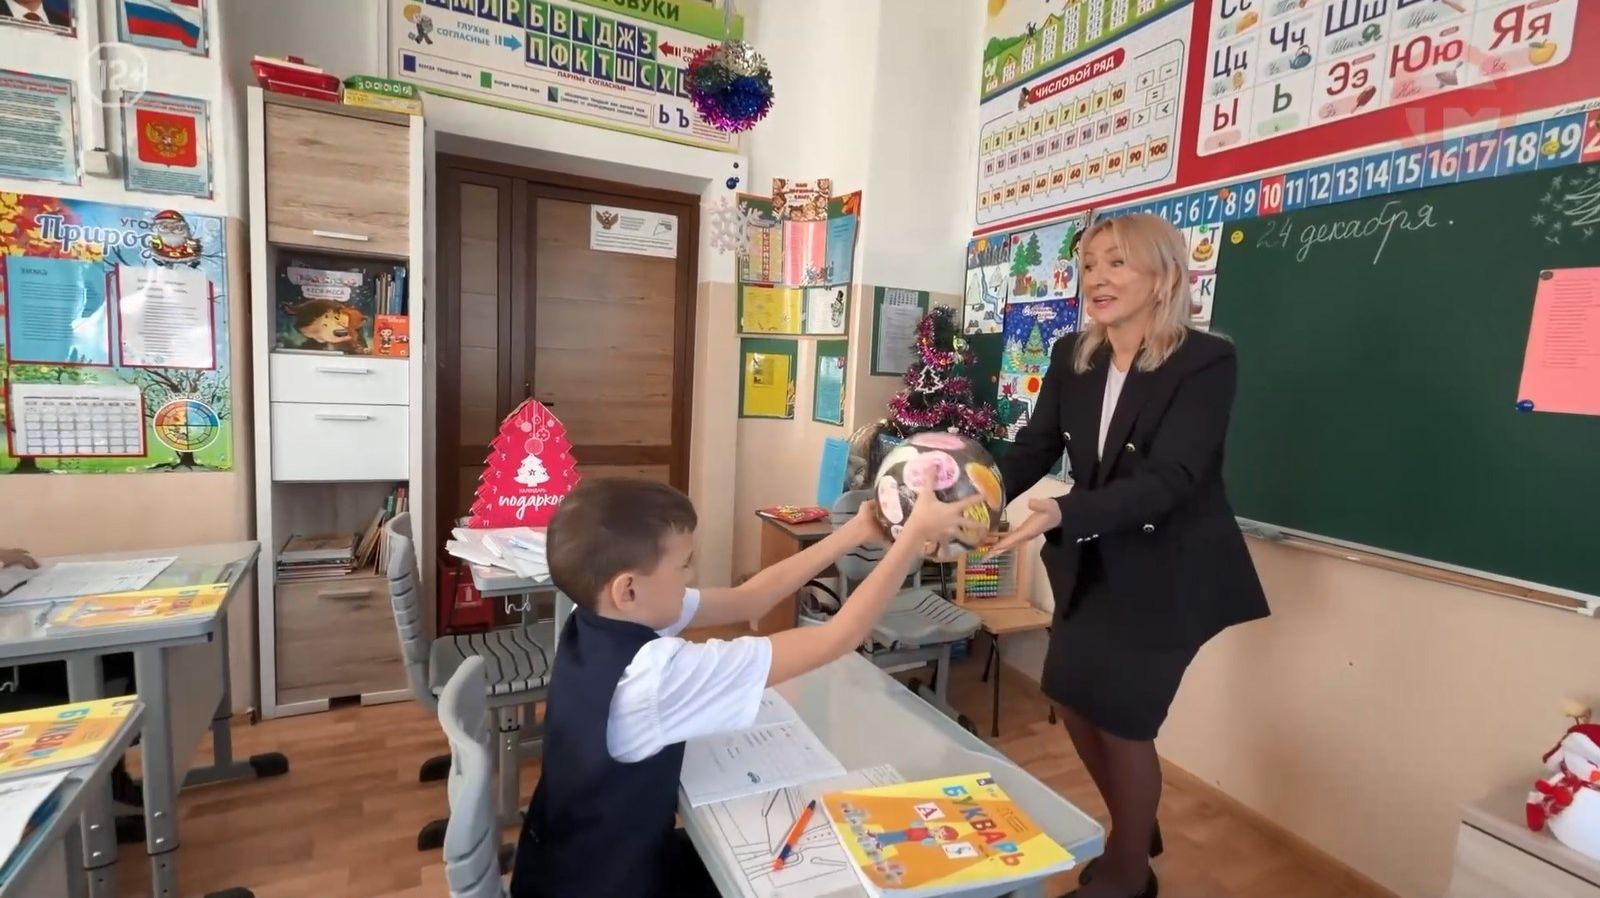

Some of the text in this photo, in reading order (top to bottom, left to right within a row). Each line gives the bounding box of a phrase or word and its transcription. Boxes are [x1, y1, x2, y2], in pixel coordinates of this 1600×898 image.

[456, 21, 490, 36] ГЛУХИЕ
[507, 0, 520, 21] Р
[530, 3, 544, 28] Б
[554, 9, 567, 33] В
[577, 16, 589, 39] Г
[597, 22, 613, 48] Д
[617, 26, 635, 52] Ж
[641, 33, 652, 54] З
[1325, 0, 1387, 37] Шш
[1488, 4, 1552, 51] Яя
[436, 27, 491, 47] СОГЛАСНЫЕ
[1270, 21, 1306, 53] Чч
[530, 37, 672, 91] П Ф К Т Ш С Х
[1213, 46, 1248, 78] Цц
[1389, 35, 1464, 78] Юю
[557, 71, 627, 91] ПАРНЫЕ СОГЛАСНЫЕ
[1035, 56, 1115, 97] ЧИСЛОВОЙ РЯД
[1326, 61, 1369, 96] Ээ
[1096, 97, 1103, 107] 9
[1112, 89, 1122, 101] 10
[1272, 83, 1292, 114] Ь
[676, 107, 690, 128] Ъ
[1116, 116, 1127, 128] 20
[1213, 97, 1239, 132] Ы
[1006, 188, 1015, 198] 20
[1069, 168, 1081, 180] 60
[1088, 162, 1100, 174] 70
[1108, 156, 1121, 169] 80
[1129, 151, 1142, 163] 90
[1149, 143, 1168, 157] 100
[1173, 202, 1183, 225] 5
[1189, 199, 1200, 222] 6
[1206, 195, 1219, 219] 7
[1225, 191, 1236, 216] 8
[1244, 188, 1256, 213] 9
[1262, 182, 1281, 209] 10
[1286, 178, 1303, 205] 11
[1310, 172, 1331, 201] 12
[1336, 166, 1360, 196] 13
[1365, 159, 1389, 191] 14
[1395, 153, 1422, 185] 15
[1428, 146, 1459, 179] 16
[1464, 139, 1498, 174] 17
[1503, 131, 1538, 168] 18
[1544, 123, 1582, 160] 19
[1208, 226, 1220, 244] Т
[1256, 217, 1293, 249] 24
[1200, 278, 1213, 297] К
[941, 785, 1025, 866] БУКВАРЬ
